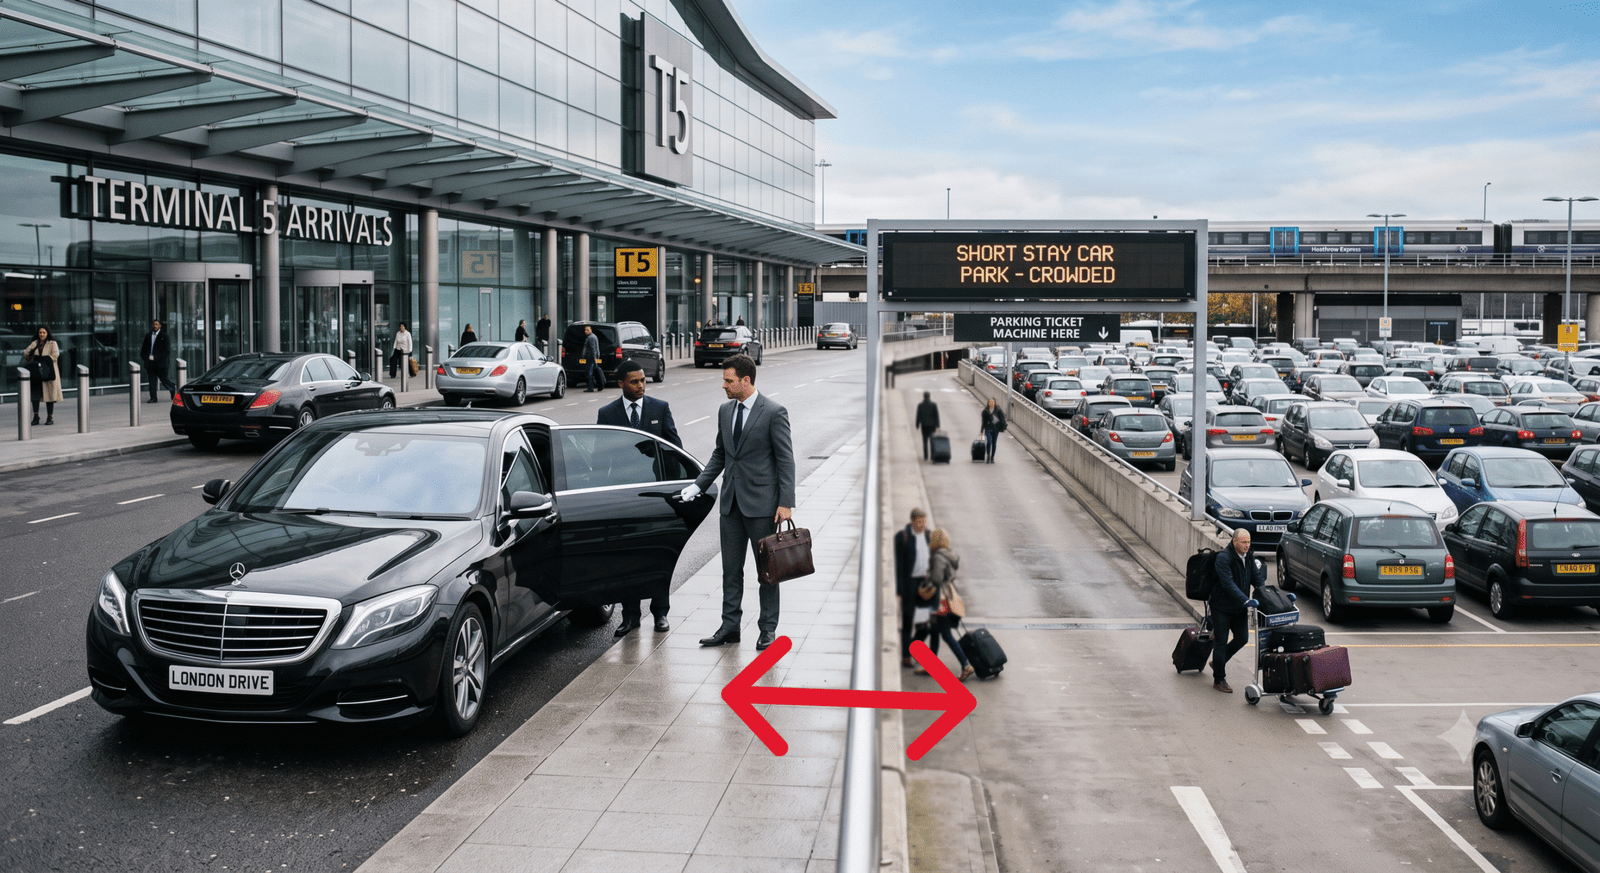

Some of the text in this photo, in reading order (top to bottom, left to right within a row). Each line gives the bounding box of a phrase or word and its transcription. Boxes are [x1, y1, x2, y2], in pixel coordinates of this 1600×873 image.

[649, 54, 690, 155] T5
[84, 174, 393, 247] TERMINAL 5 ARRIVALS
[956, 244, 1115, 262] SHORT STAY CAR
[1339, 246, 1361, 254] Express
[620, 251, 650, 273] T5
[960, 266, 1010, 283] PARK
[1029, 266, 1116, 283] CROWDED
[990, 316, 1084, 327] PARKING TICKET
[993, 328, 1080, 339] MACHINE HERE
[172, 670, 270, 690] LONDON DRIVE
